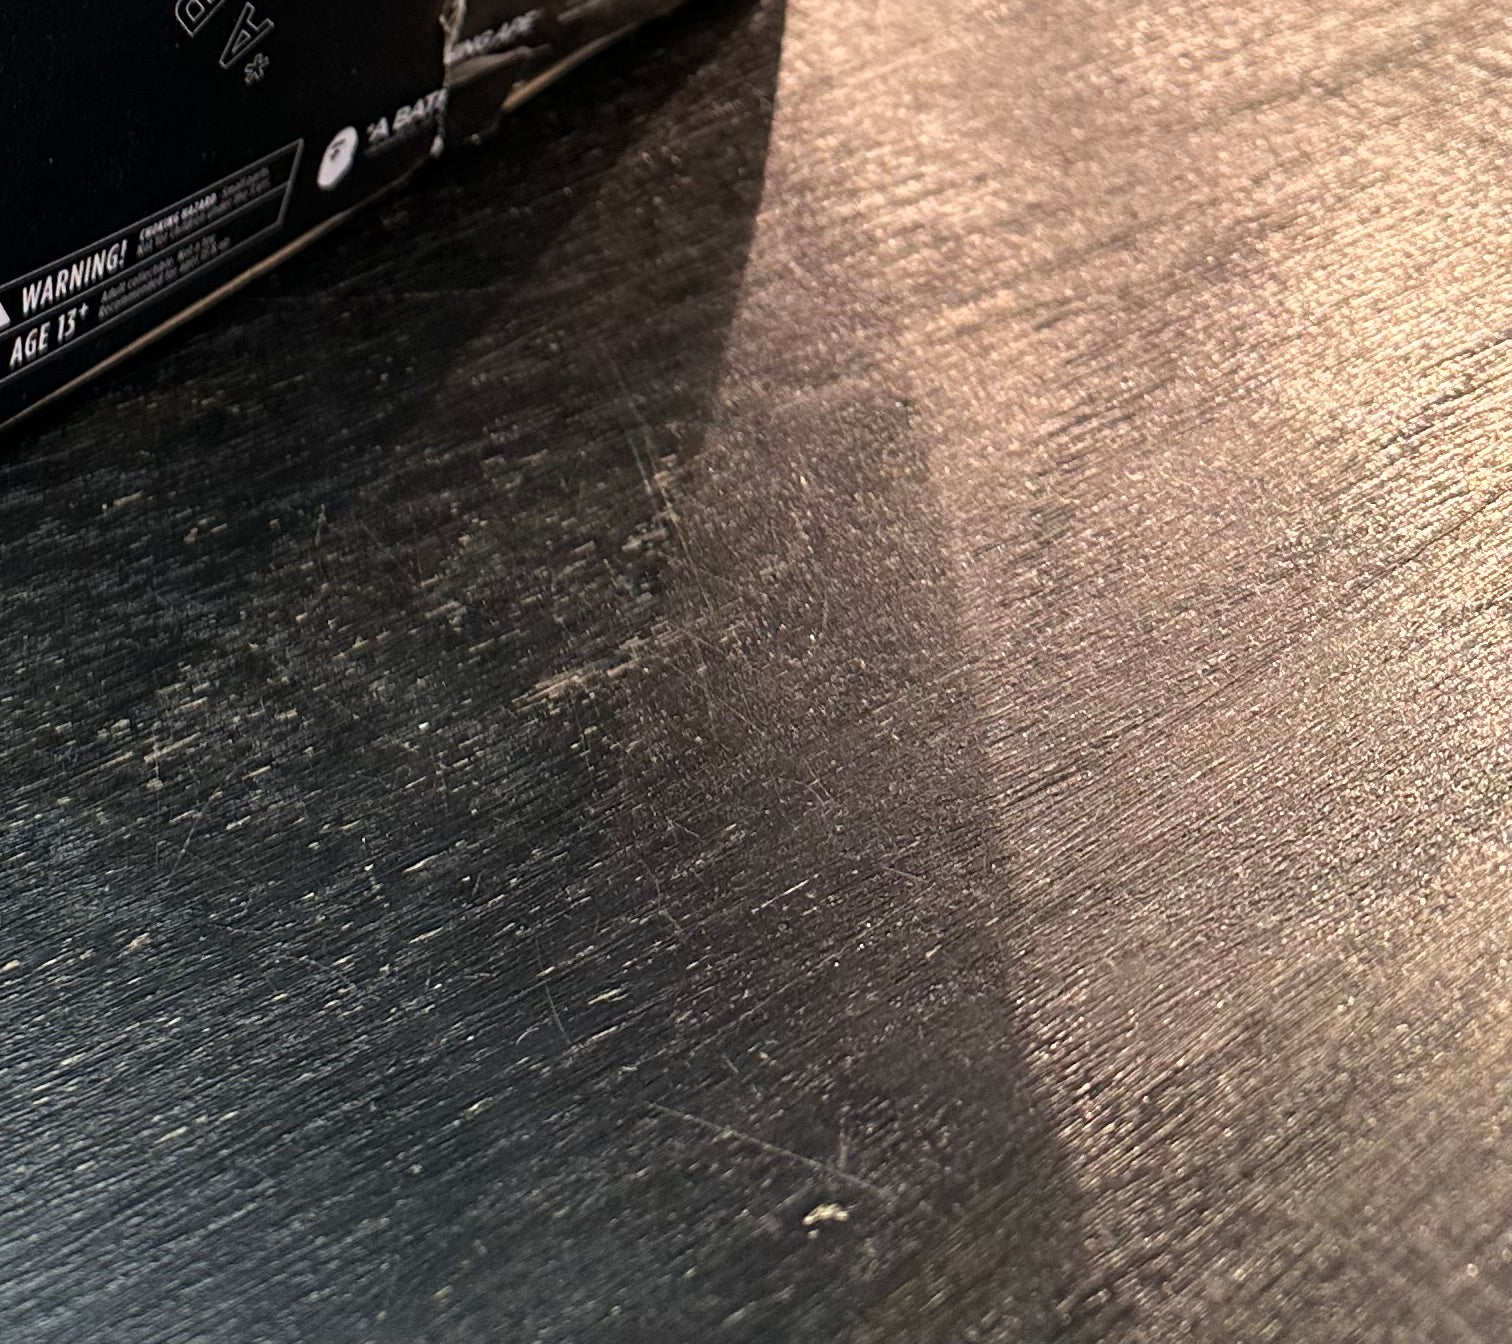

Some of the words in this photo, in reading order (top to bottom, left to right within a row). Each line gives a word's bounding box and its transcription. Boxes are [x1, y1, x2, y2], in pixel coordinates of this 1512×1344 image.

[22, 238, 129, 316] WARNING!
[9, 321, 51, 370] AGE
[57, 302, 89, 344] 13+
